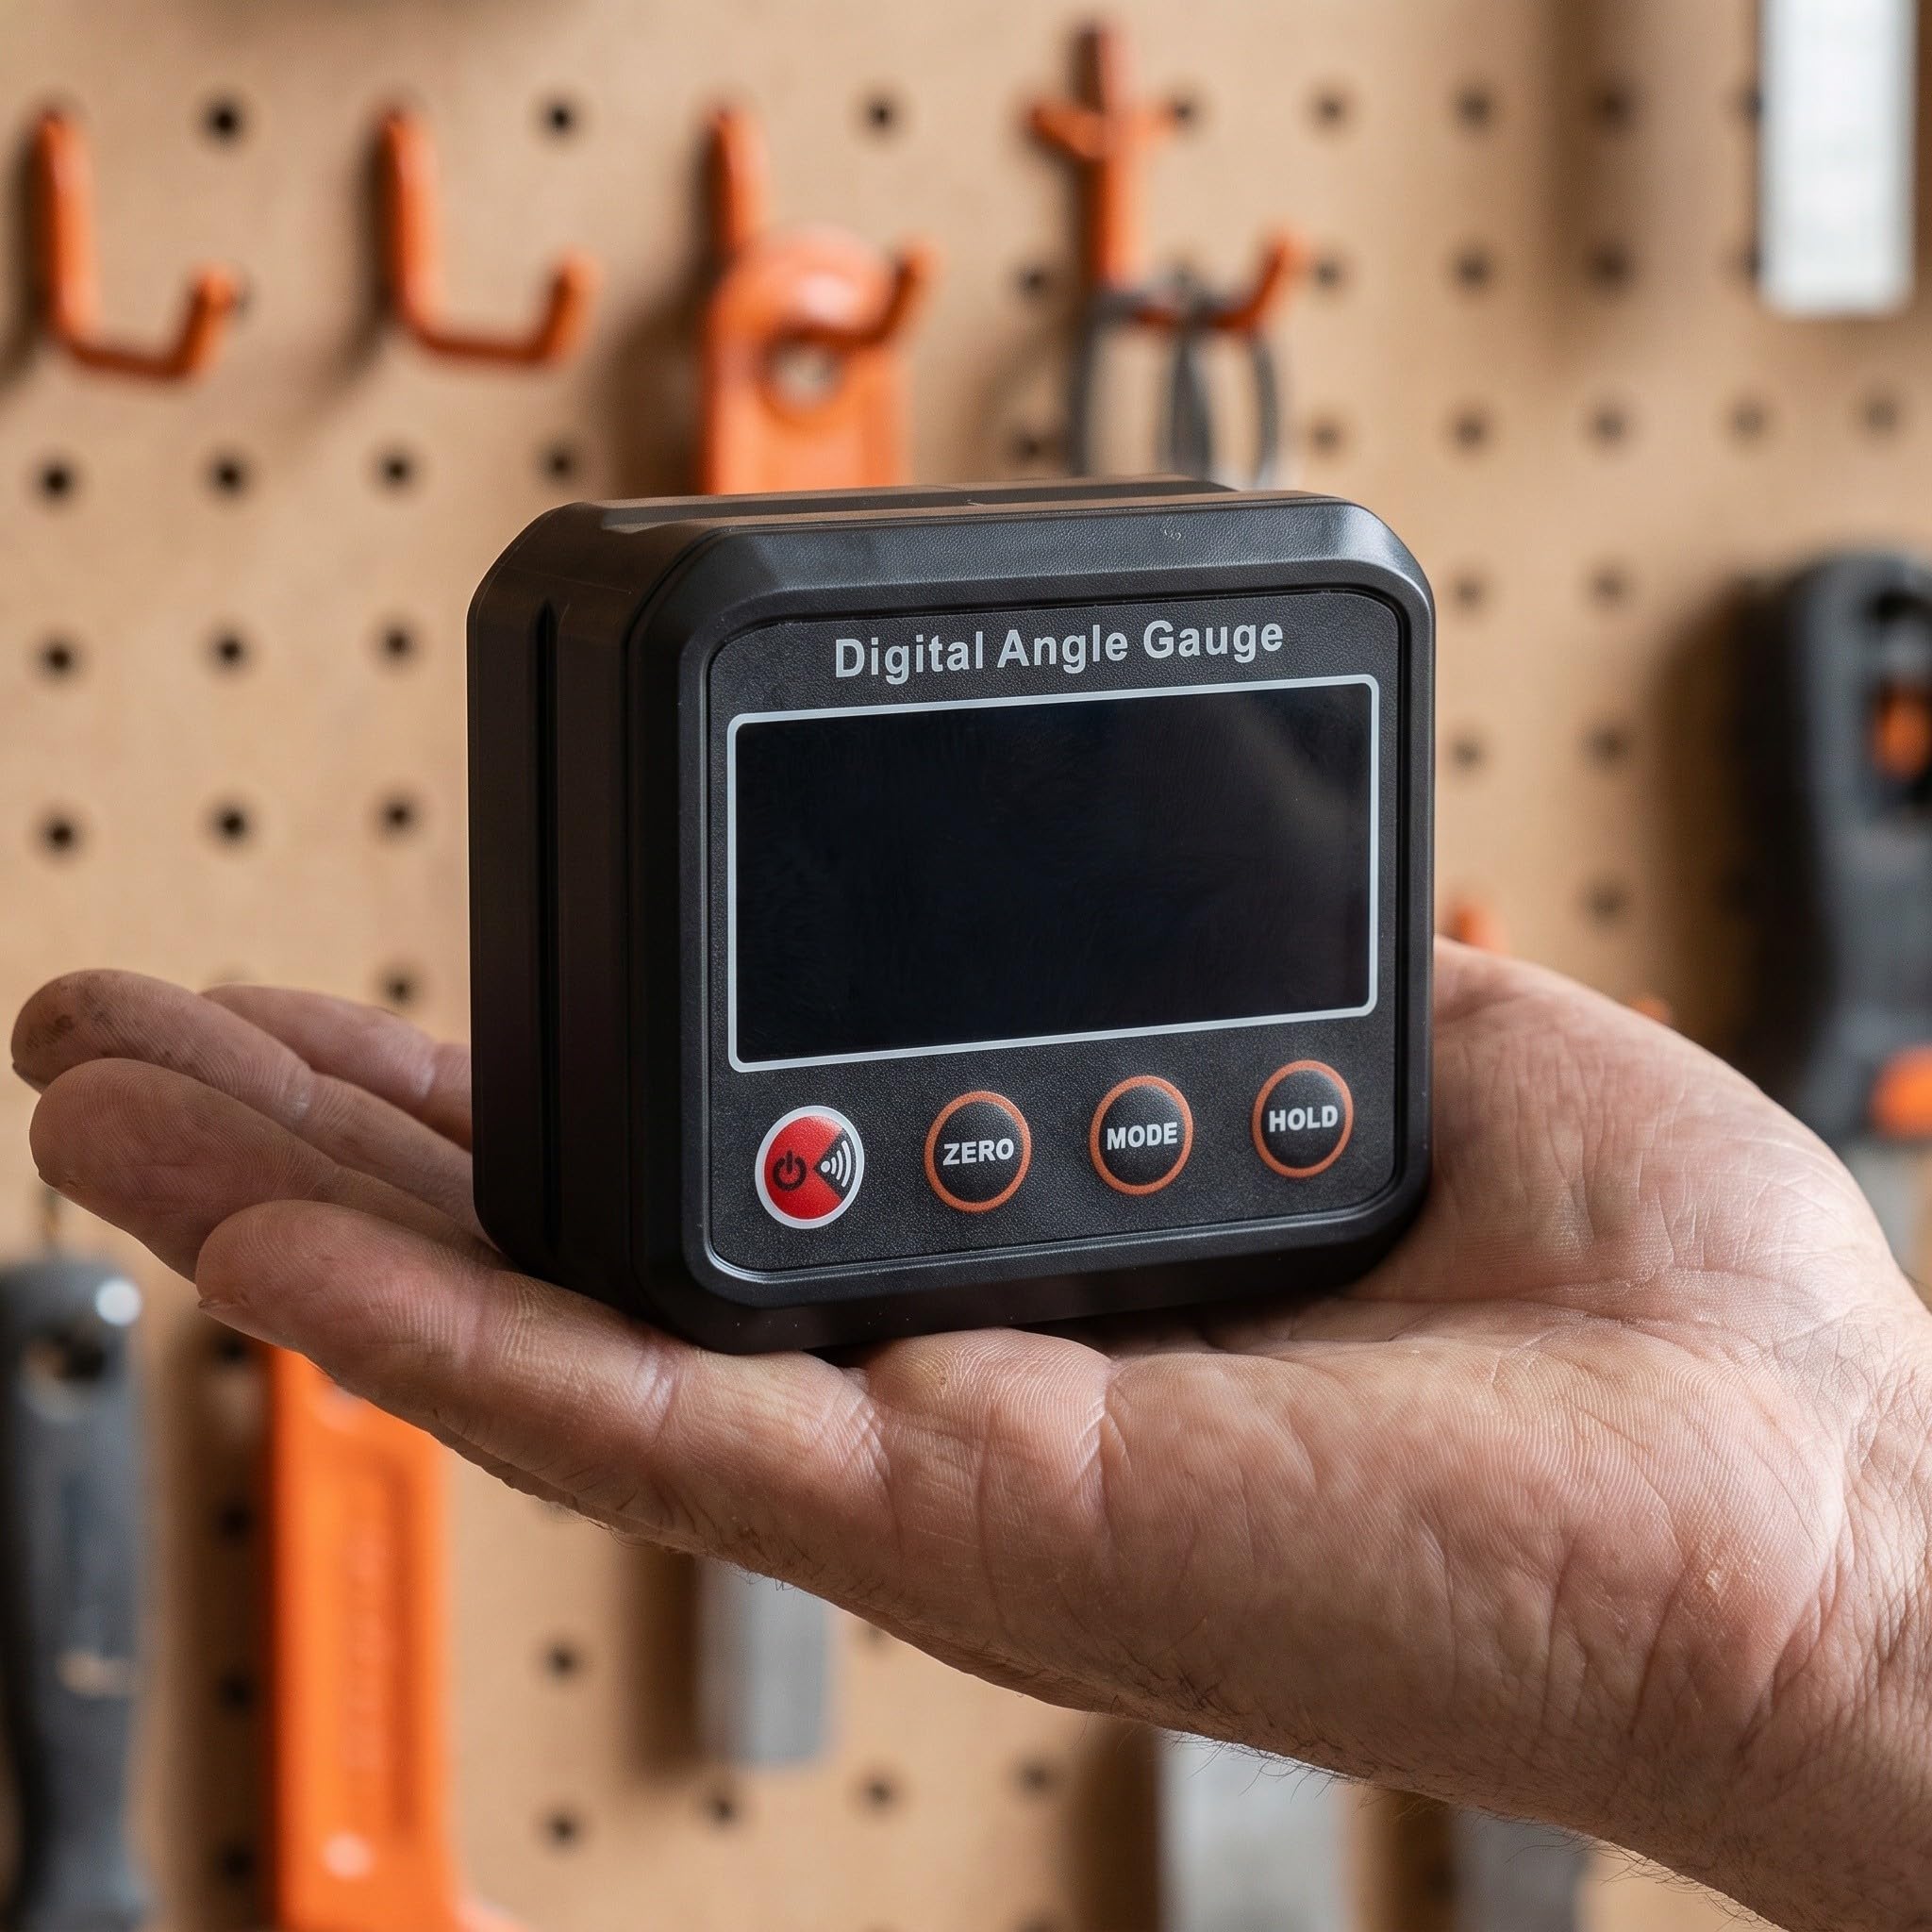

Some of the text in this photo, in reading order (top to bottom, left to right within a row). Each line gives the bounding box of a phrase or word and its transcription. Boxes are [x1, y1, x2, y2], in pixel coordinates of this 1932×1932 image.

[835, 619, 1284, 686] Digital Angle Gauge
[1269, 1104, 1339, 1133] HOLD
[1107, 1121, 1179, 1151] MODE
[942, 1137, 1015, 1166] ZERO
